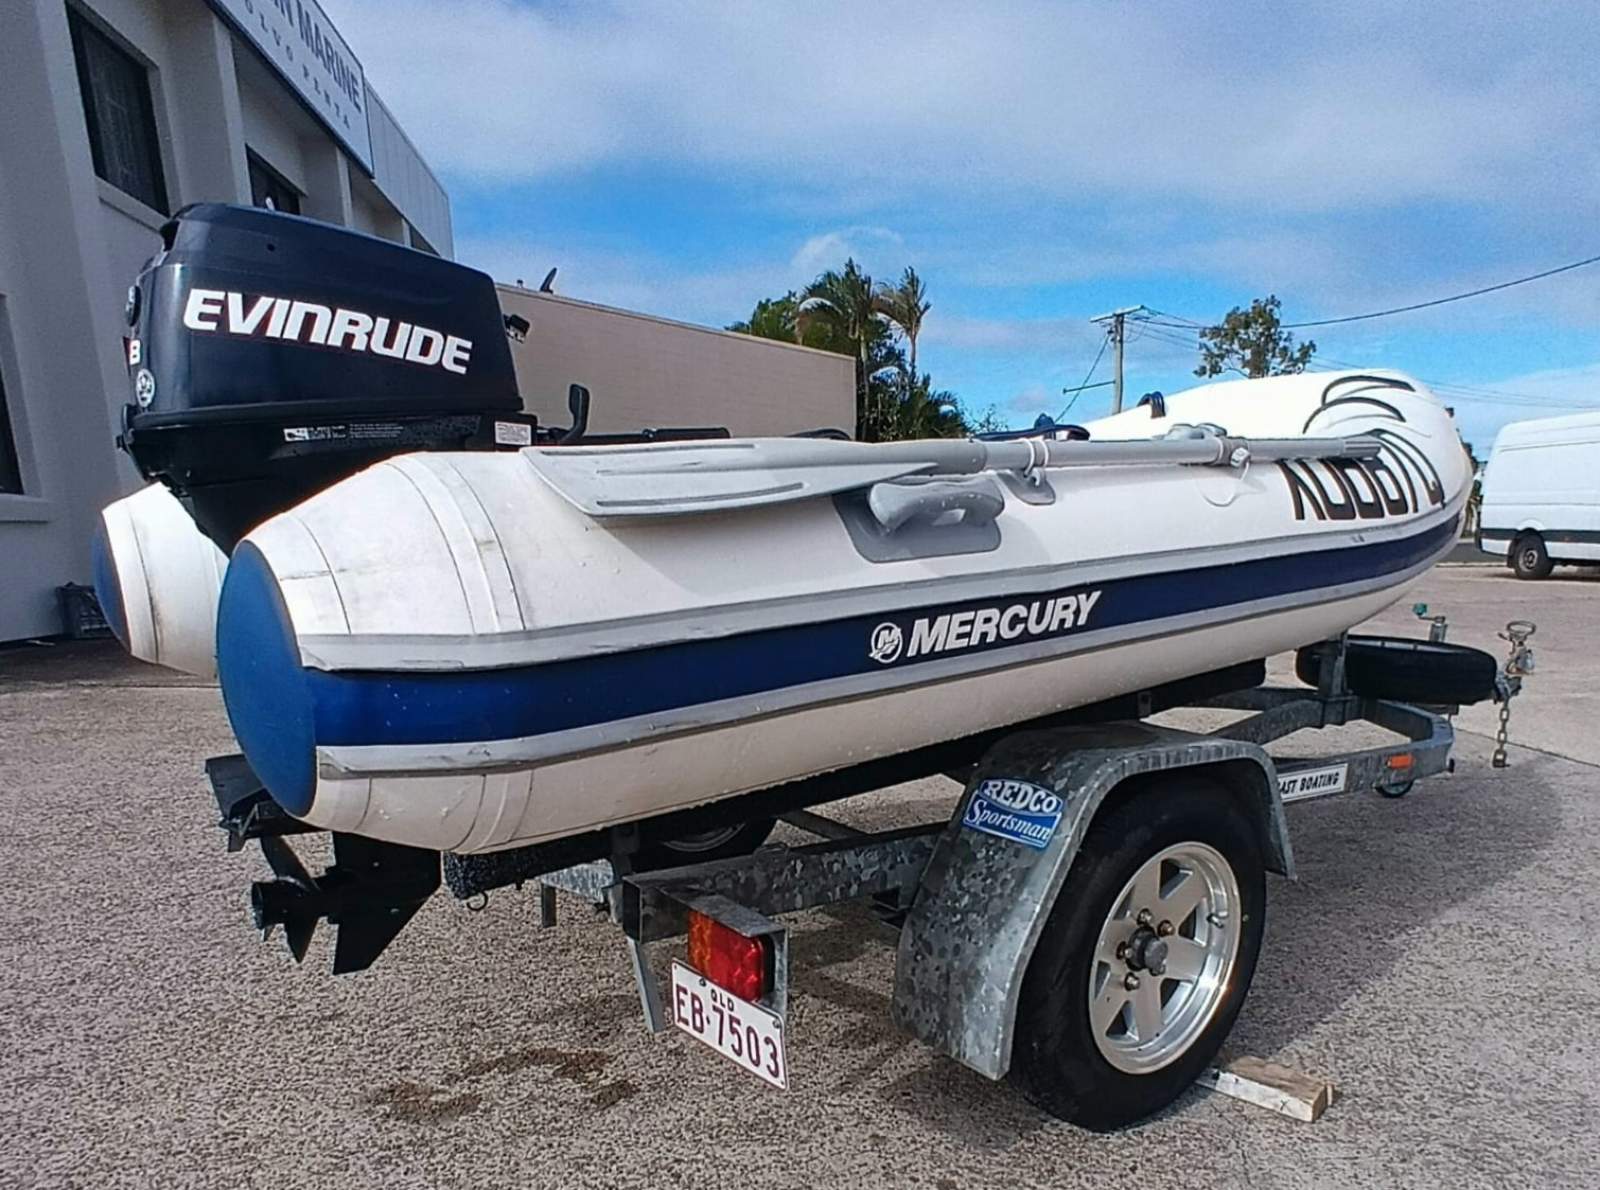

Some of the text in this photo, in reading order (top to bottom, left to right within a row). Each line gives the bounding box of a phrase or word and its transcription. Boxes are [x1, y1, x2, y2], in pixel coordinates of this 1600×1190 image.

[296, 0, 361, 113] MARINE
[183, 288, 473, 374] EVINRUDE
[906, 590, 1102, 657] MERCURY
[984, 780, 1058, 813] REDCO
[1279, 771, 1340, 795] AST BOATING
[966, 799, 1051, 841] Sportsman
[710, 988, 735, 1012] QLD
